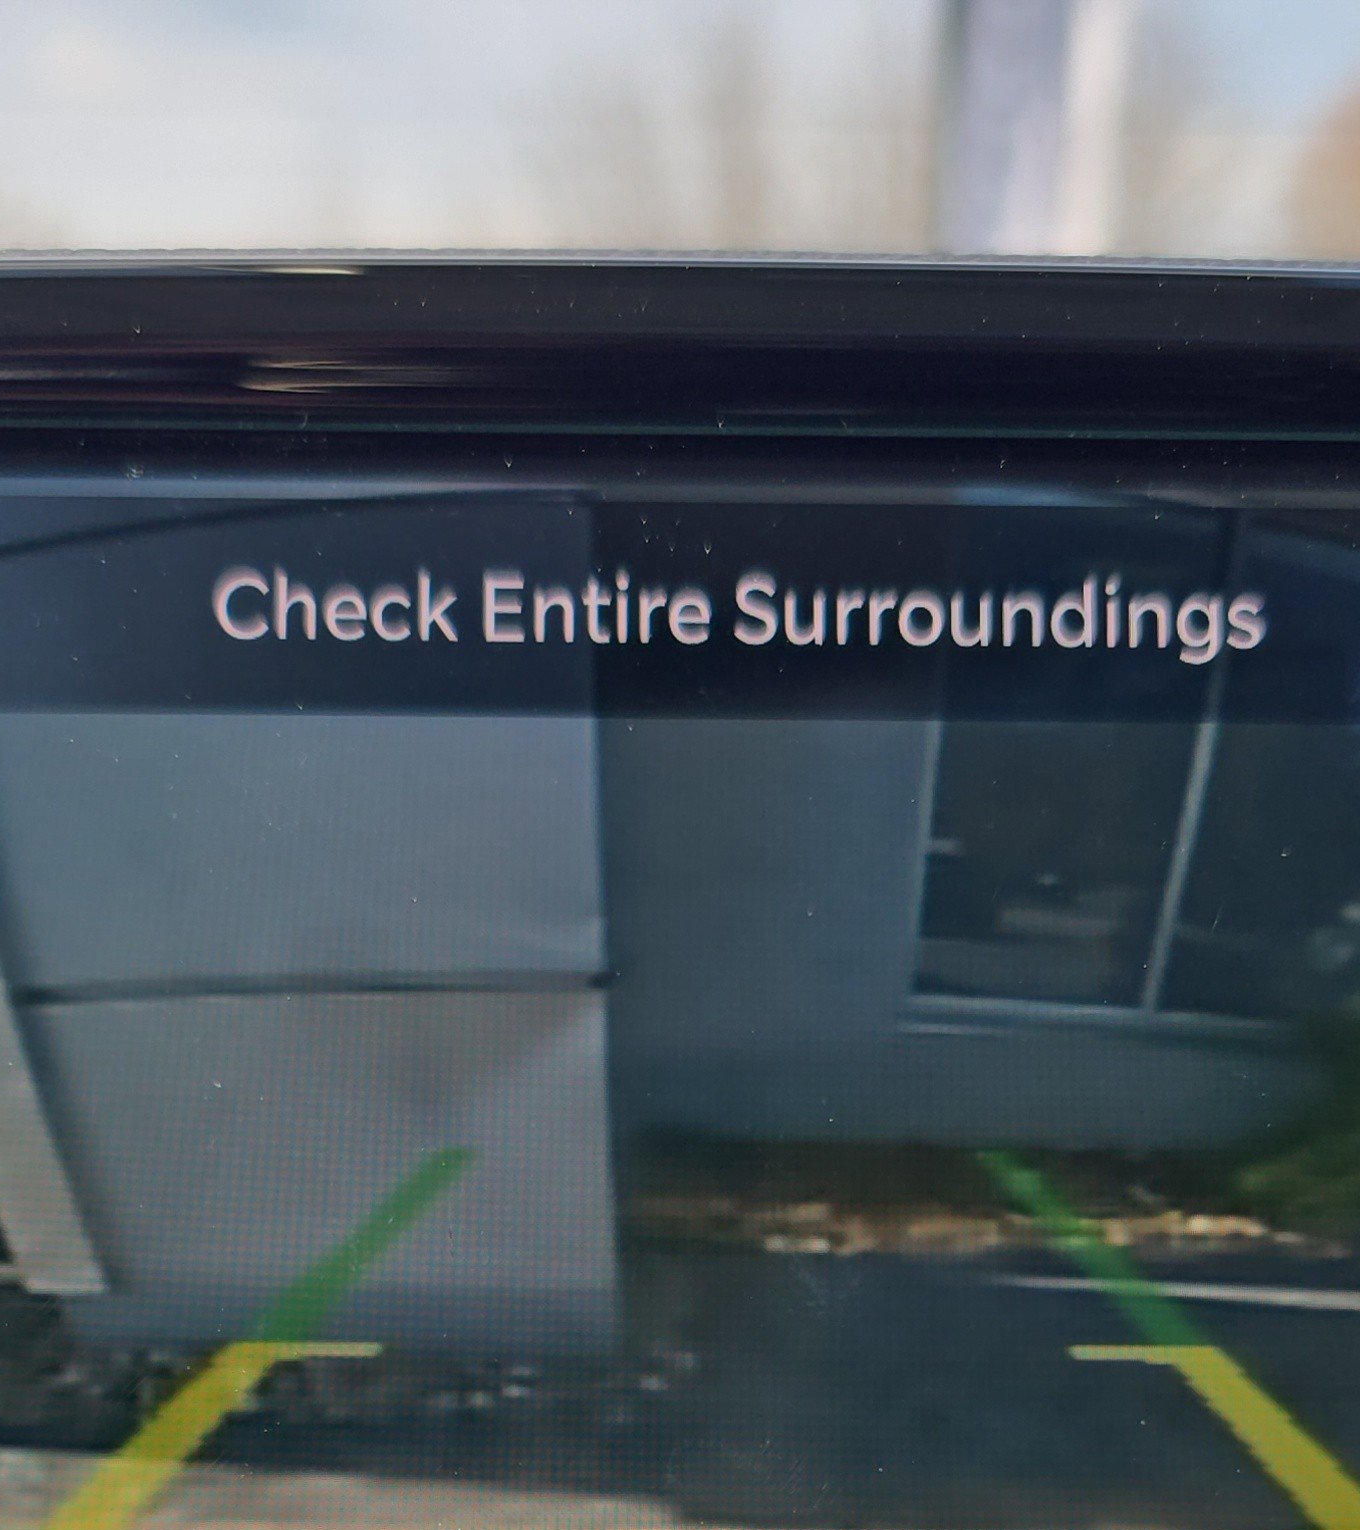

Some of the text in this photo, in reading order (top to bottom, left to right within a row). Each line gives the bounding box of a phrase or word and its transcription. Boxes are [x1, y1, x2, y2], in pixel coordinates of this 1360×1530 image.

[211, 567, 1267, 666] Check Entire Surroundings
